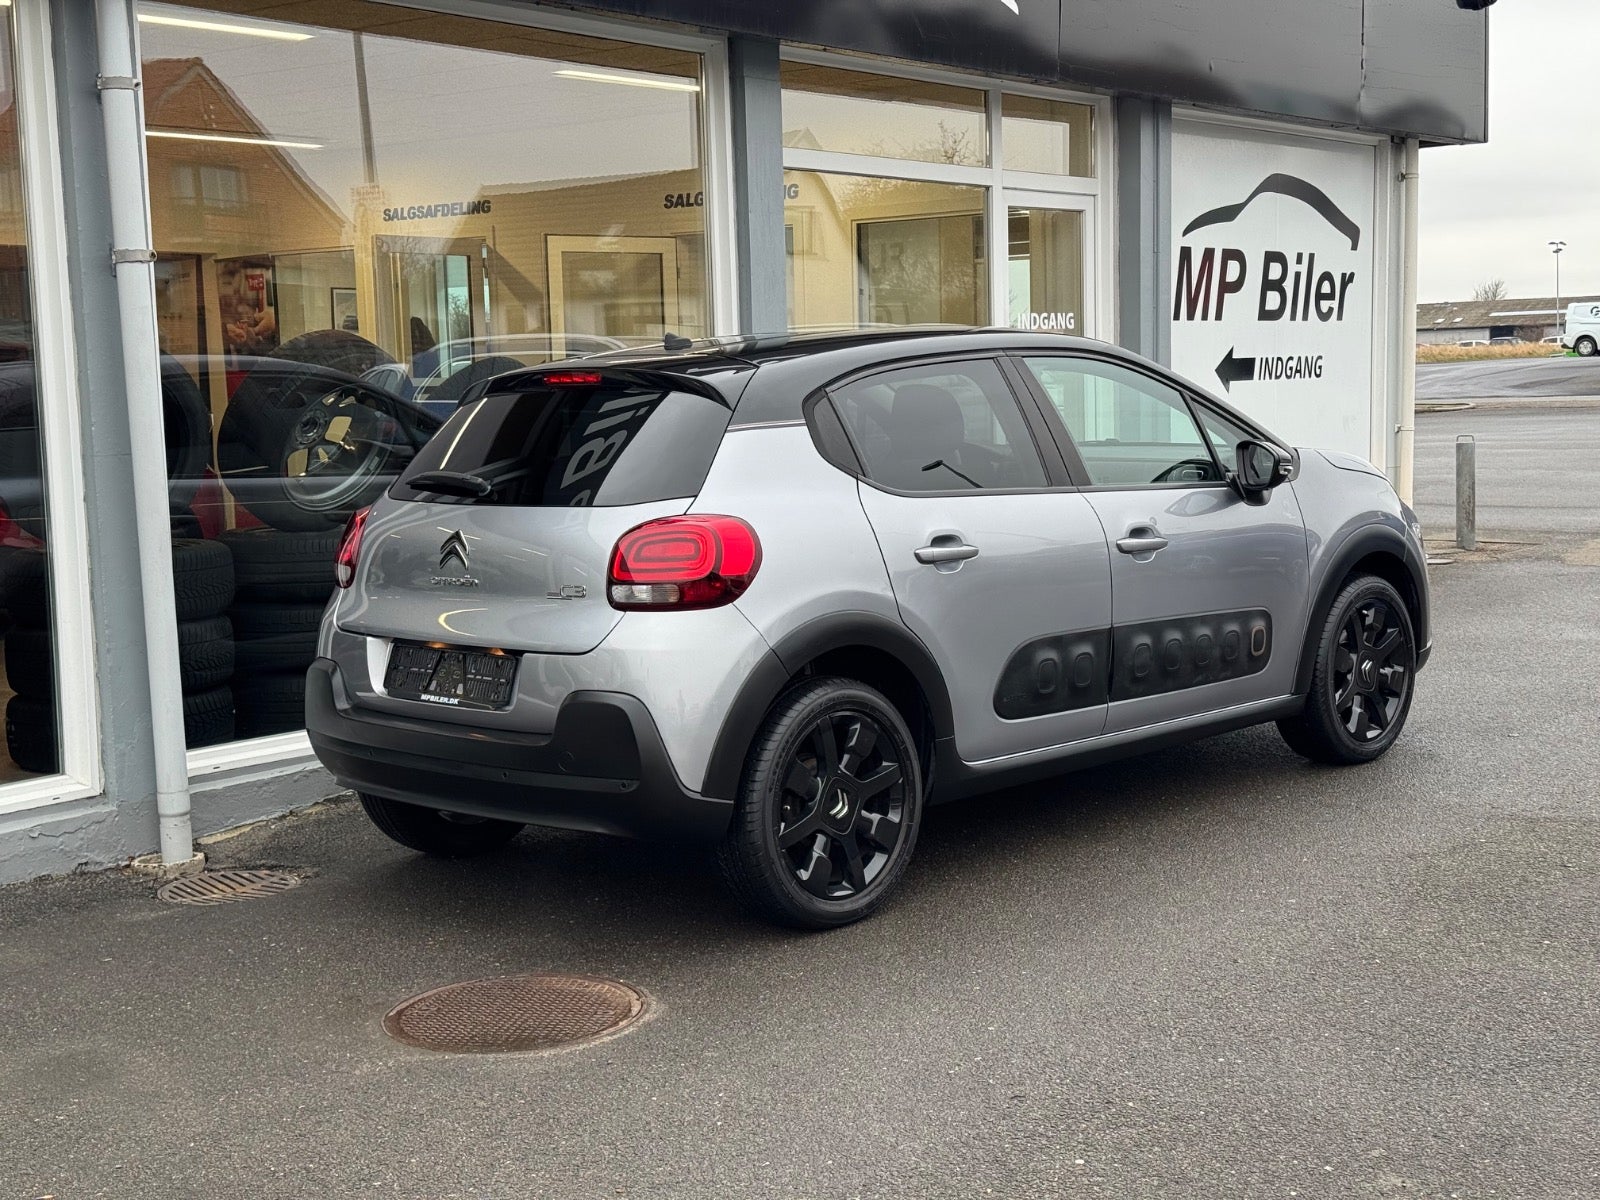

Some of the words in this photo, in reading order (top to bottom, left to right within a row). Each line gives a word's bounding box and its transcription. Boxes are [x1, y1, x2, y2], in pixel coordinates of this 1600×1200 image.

[383, 199, 492, 222] SALGSAFDELING
[1172, 245, 1247, 322] MP
[1257, 250, 1356, 323] Biler
[1017, 312, 1075, 330] INDGANG
[1257, 355, 1323, 381] INDGANG
[560, 584, 587, 598] C3
[420, 693, 460, 705] MPBILER.DK
